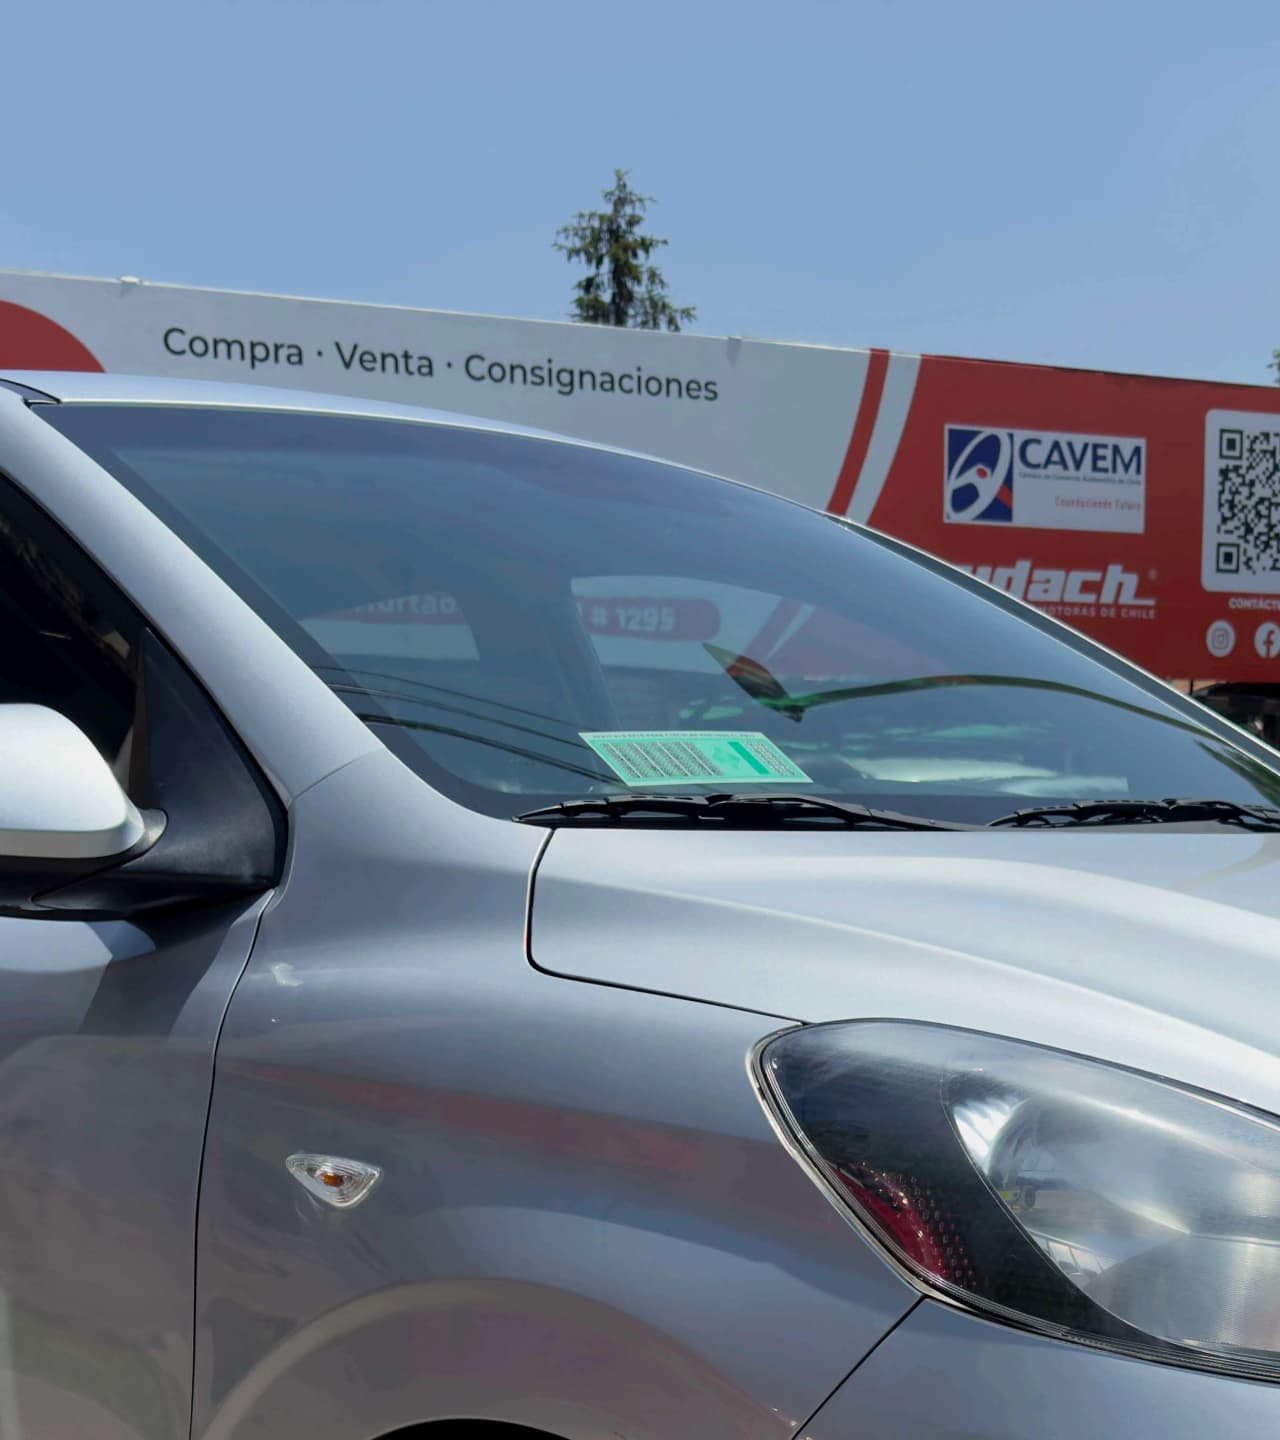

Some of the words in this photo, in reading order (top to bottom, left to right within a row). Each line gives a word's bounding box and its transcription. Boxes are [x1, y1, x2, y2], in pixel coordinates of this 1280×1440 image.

[163, 327, 303, 369] Compra
[334, 341, 434, 378] Venta
[464, 353, 720, 402] Consignaciones
[1019, 438, 1142, 475] CAVEM
[1121, 608, 1155, 619] CHILE
